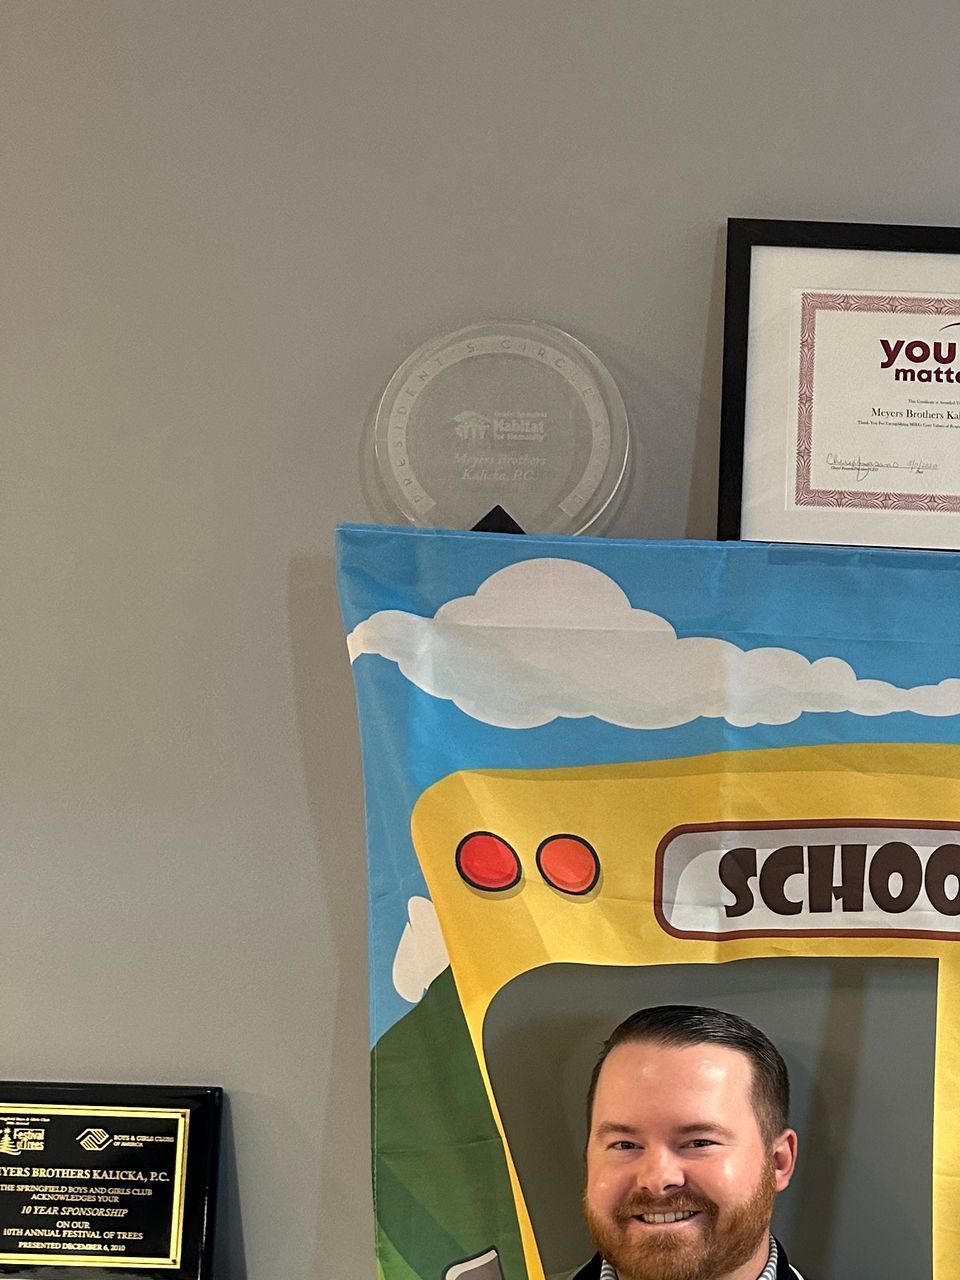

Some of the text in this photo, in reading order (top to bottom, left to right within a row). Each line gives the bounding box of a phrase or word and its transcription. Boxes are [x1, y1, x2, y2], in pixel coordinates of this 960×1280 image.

[880, 339, 957, 369] you
[871, 407, 904, 418] Meyers
[906, 409, 944, 420] Brothers
[0, 1166, 170, 1183] YERS BROTHERS KALICKA, P.C.
[16, 1185, 67, 1193] SPRINGFIELD
[68, 1186, 88, 1194] BOYS
[131, 1188, 153, 1196] CLUB
[31, 1194, 120, 1203] ACKNOWLEDGES YOUR
[21, 1206, 128, 1217] 10 YEAR SPONSORSHIP
[56, 1220, 90, 1229] ON OUR
[3, 1228, 144, 1240] 10TH ANNUAL FESTIVAL OF TREES
[62, 1243, 102, 1251] DECEMBER
